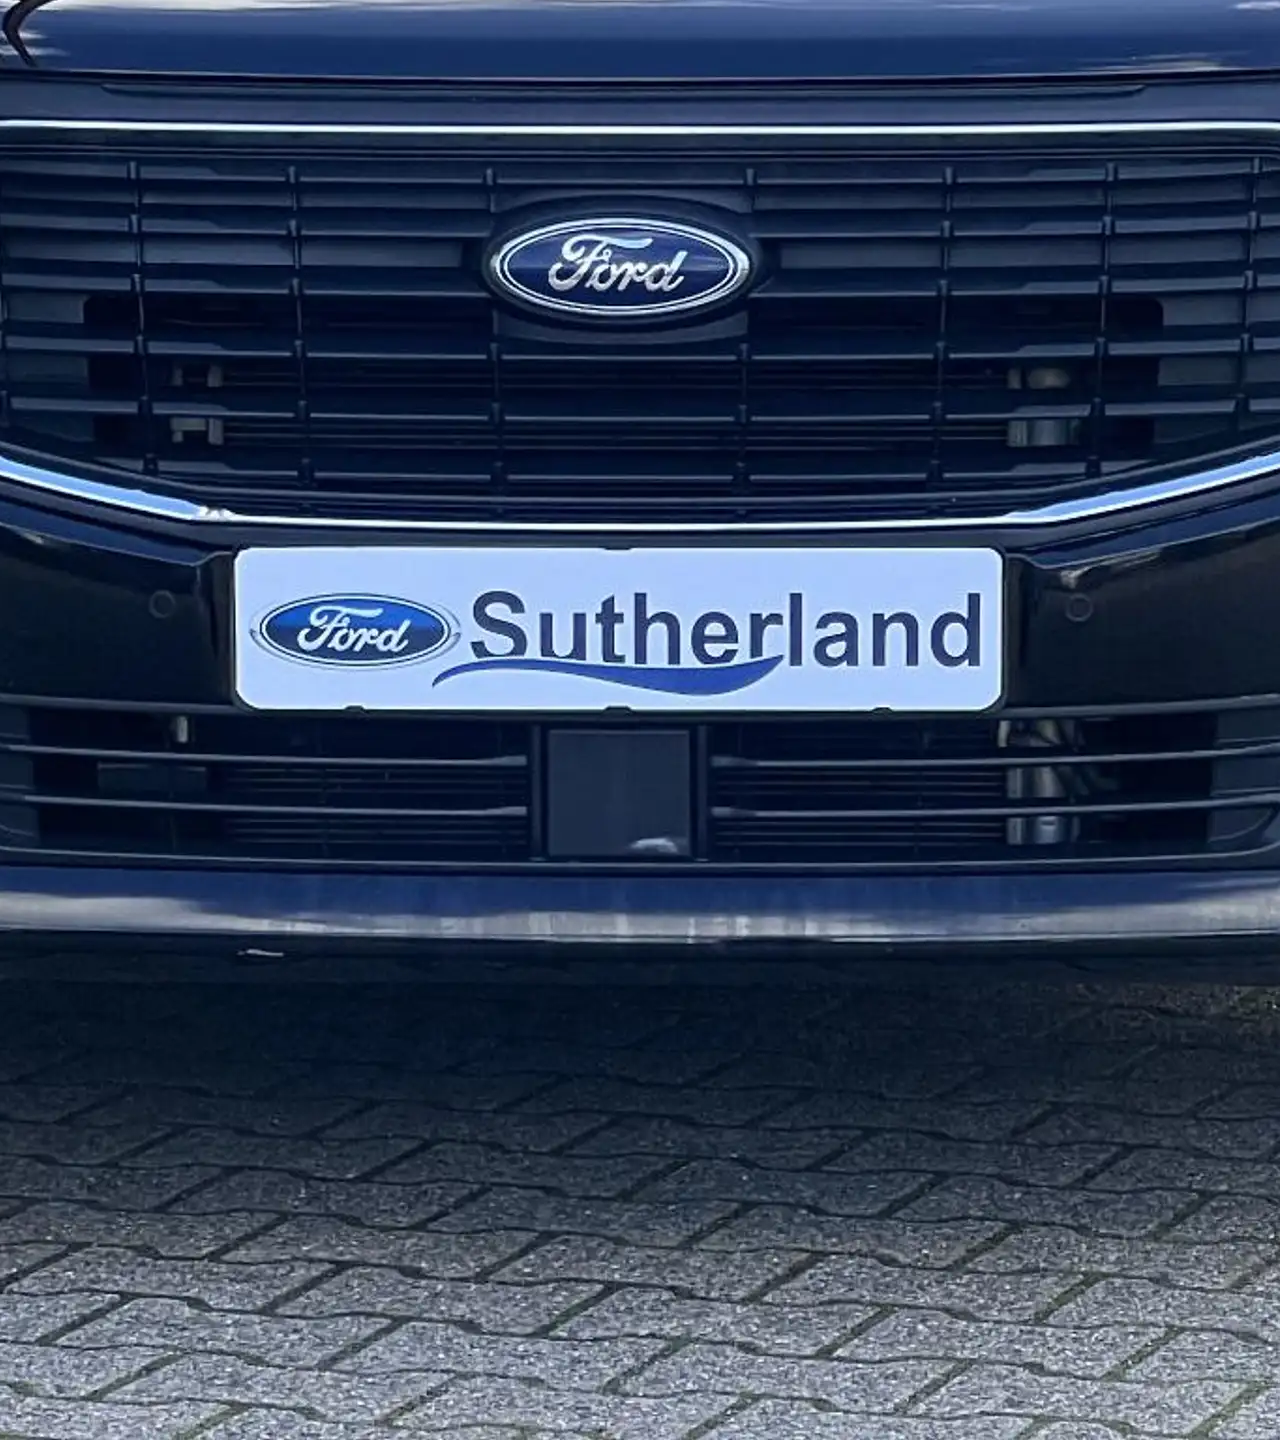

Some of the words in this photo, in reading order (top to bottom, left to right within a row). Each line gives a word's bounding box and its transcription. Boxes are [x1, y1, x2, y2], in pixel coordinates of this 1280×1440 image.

[547, 233, 689, 292] Ford
[296, 605, 411, 653] Ford
[470, 590, 981, 667] Sutherland
